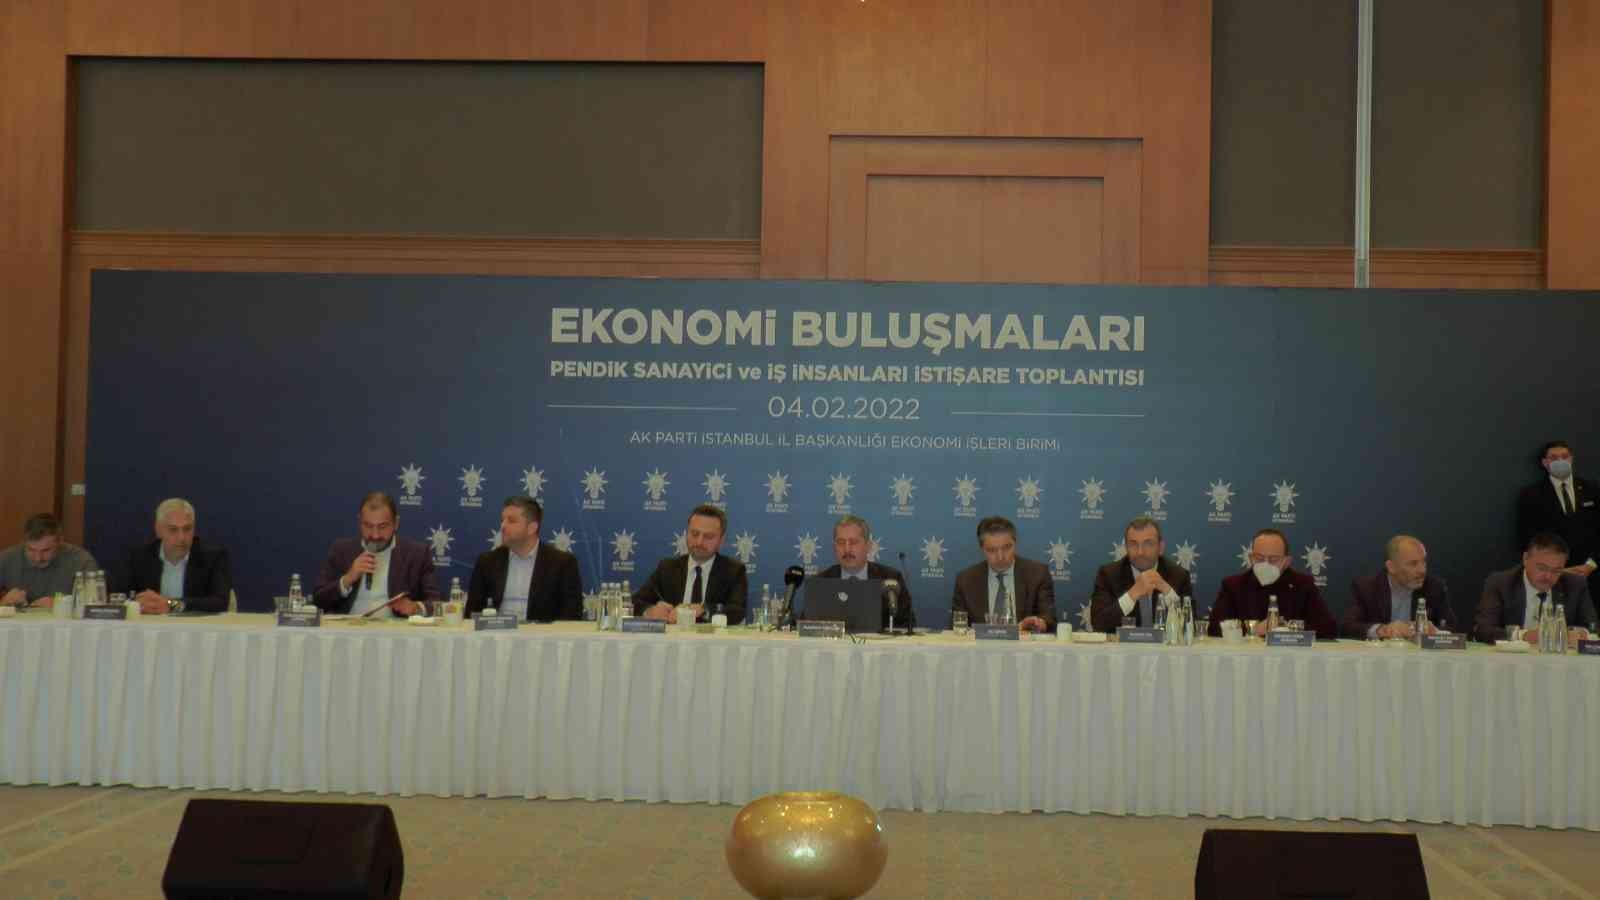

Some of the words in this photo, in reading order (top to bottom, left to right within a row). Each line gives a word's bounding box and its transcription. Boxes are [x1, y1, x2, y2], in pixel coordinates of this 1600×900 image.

[551, 307, 777, 346] EKONOMİ
[792, 311, 1145, 356] BULUŞMALARI
[550, 360, 629, 378] PENDİK
[738, 366, 762, 380] ve
[792, 363, 908, 383] İNSANLARI
[1016, 367, 1145, 386] TOPLANTISI
[768, 396, 920, 420] 04.02.2022
[629, 431, 651, 444] AK
